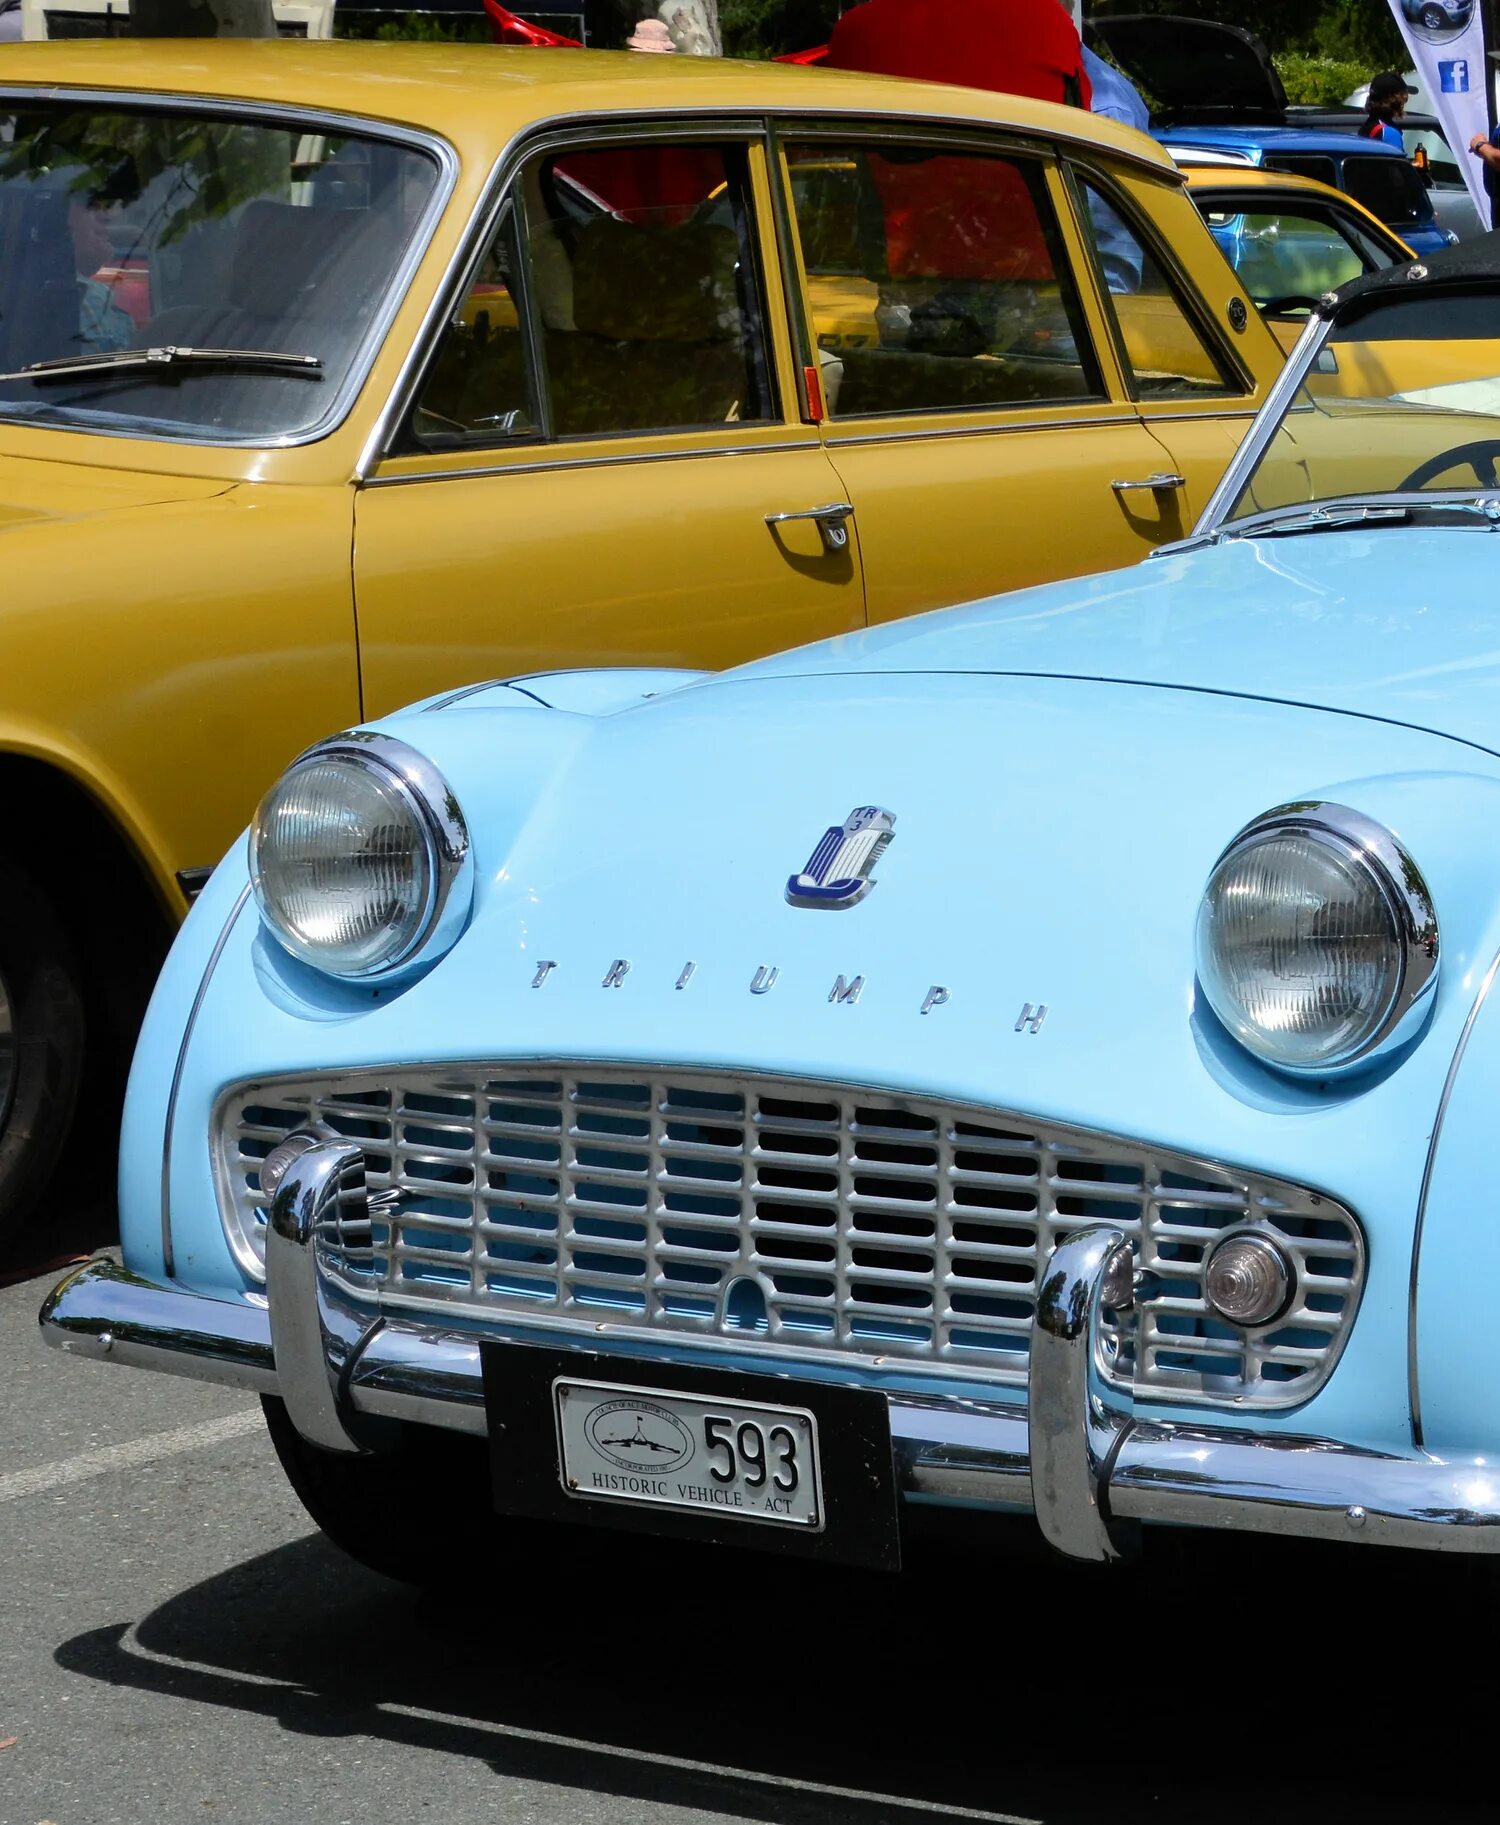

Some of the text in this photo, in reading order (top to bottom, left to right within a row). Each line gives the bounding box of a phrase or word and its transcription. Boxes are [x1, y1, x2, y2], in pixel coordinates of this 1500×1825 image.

[849, 820, 863, 831] 3
[853, 808, 877, 819] TR
[531, 958, 1049, 1035] TRIUMPH
[704, 1416, 799, 1493] 593
[592, 1472, 668, 1497] HISTORIC
[677, 1484, 743, 1507] VEHICLE
[764, 1497, 793, 1514] ACT
